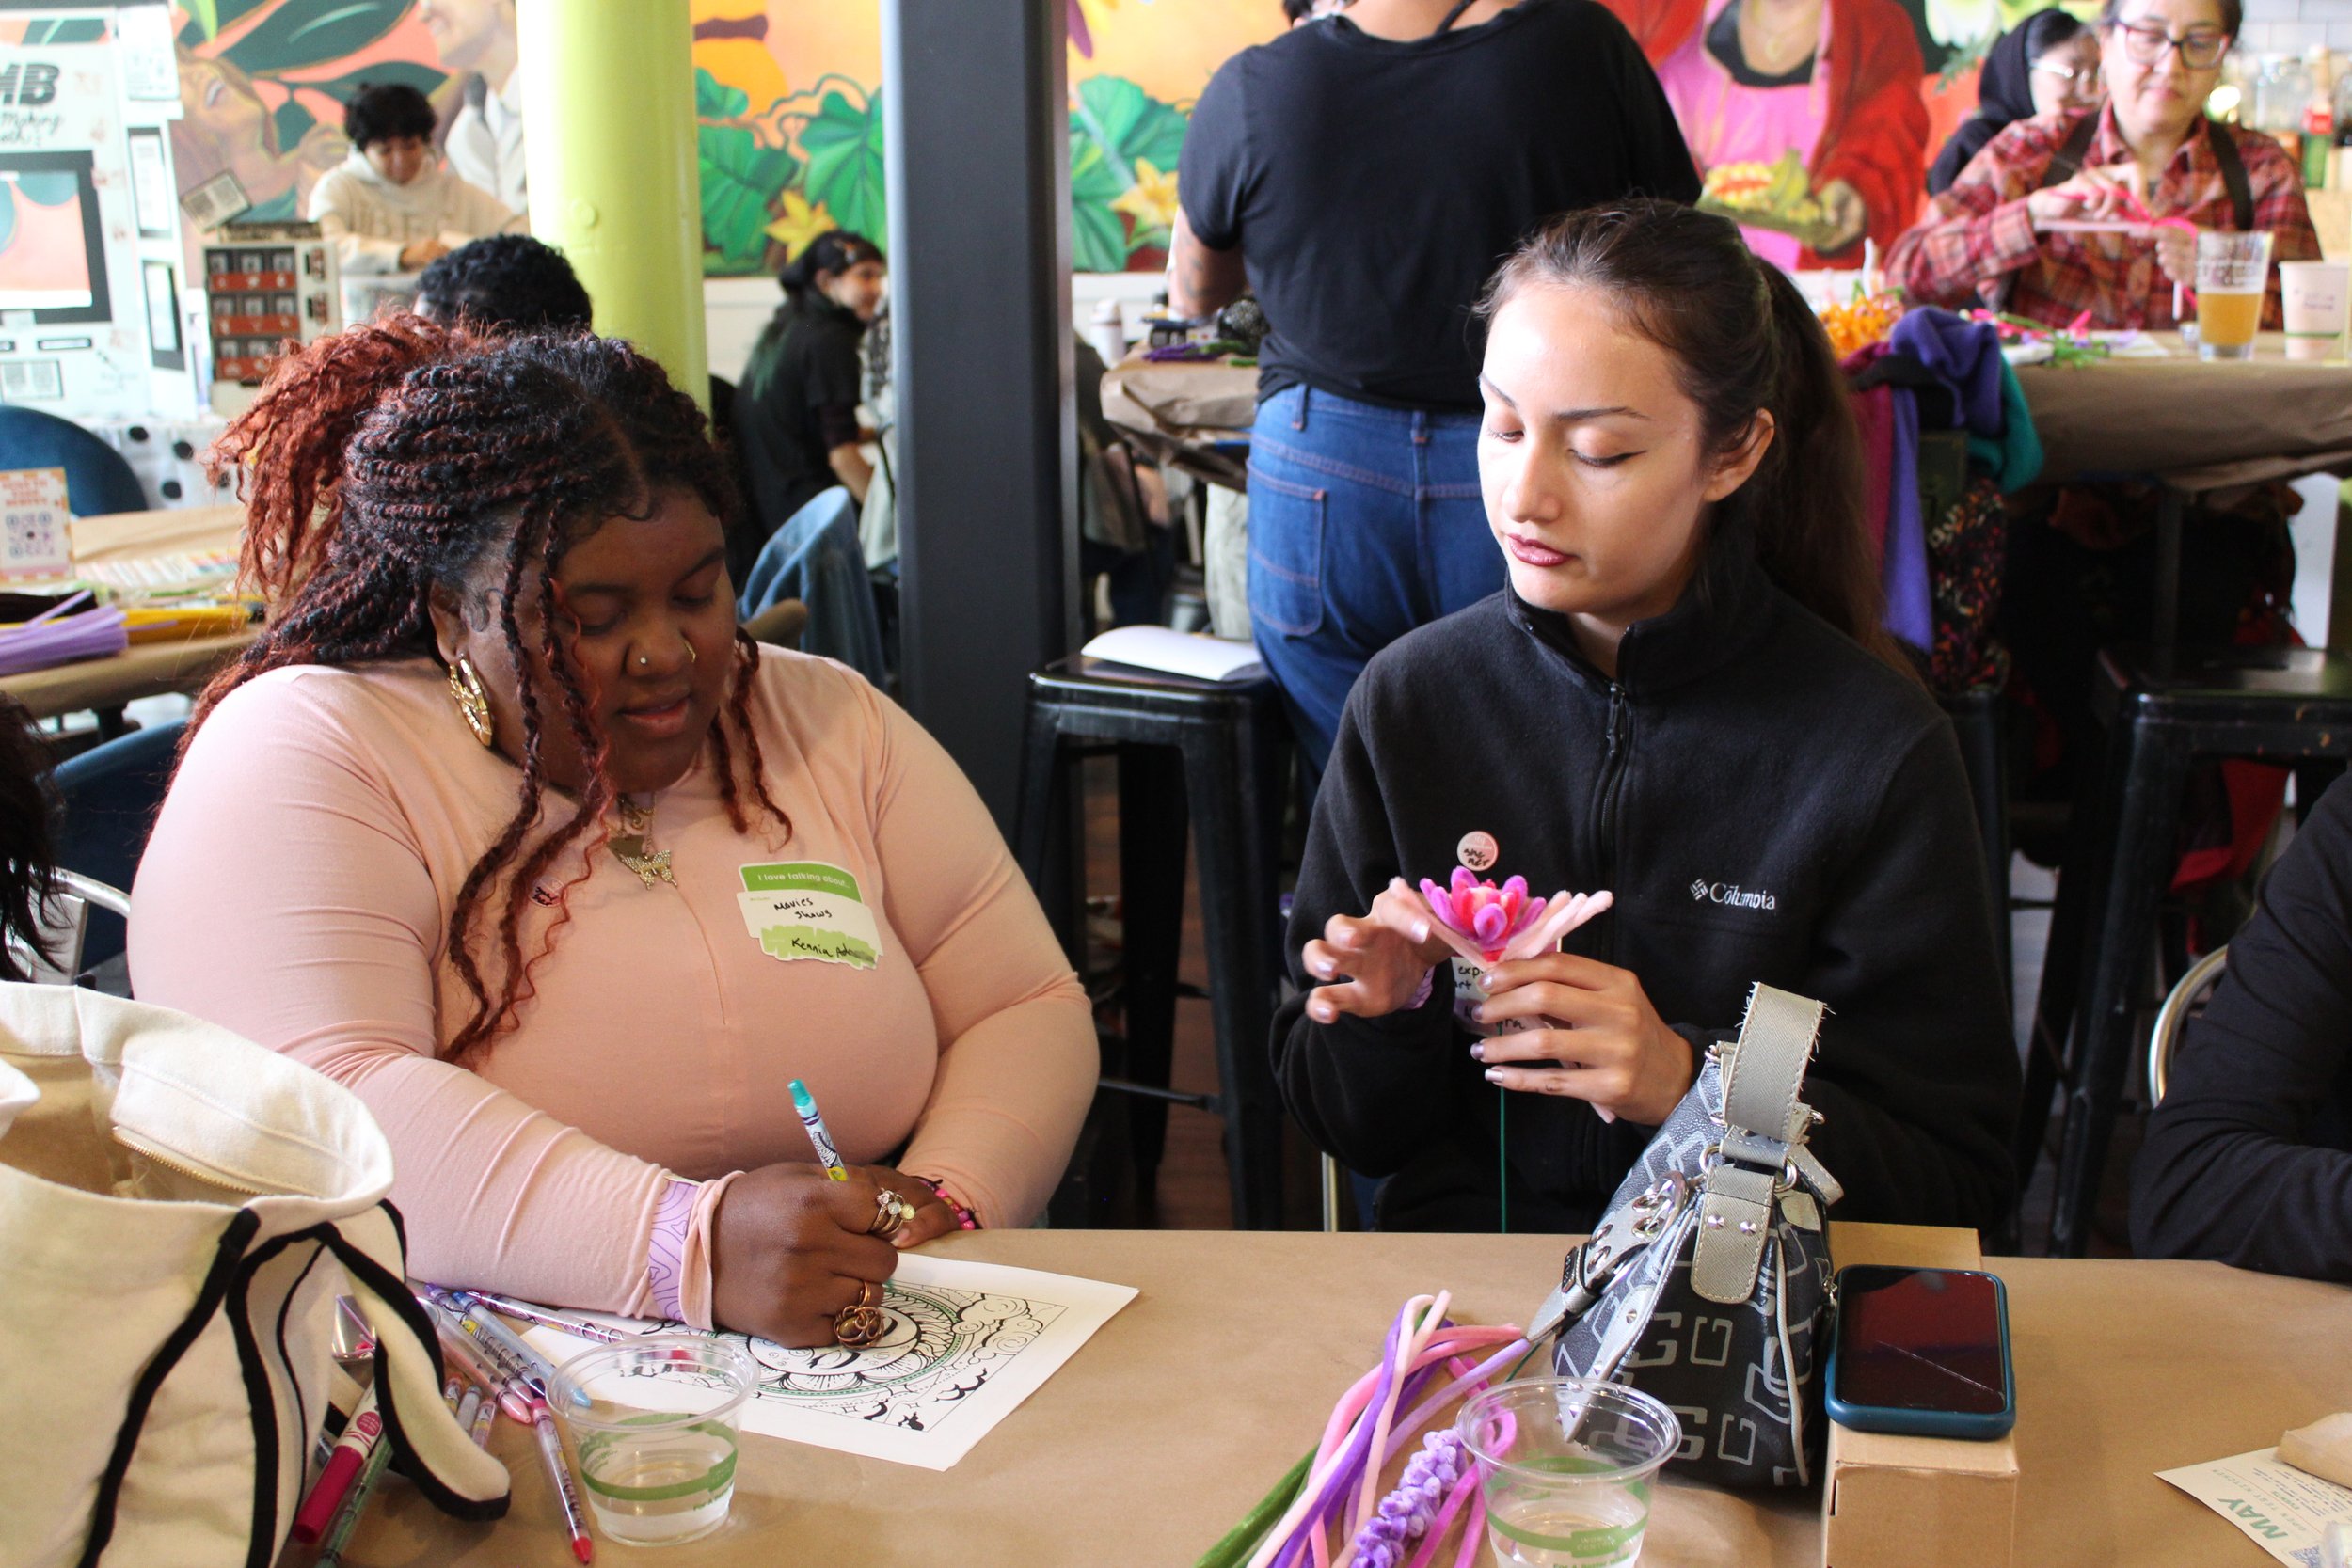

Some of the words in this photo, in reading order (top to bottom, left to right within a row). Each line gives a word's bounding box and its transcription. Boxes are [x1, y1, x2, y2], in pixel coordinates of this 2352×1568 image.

[763, 873, 786, 881] love
[787, 872, 821, 883] talking
[1709, 882, 1776, 910] Columbia
[2217, 1497, 2289, 1540] MAY
